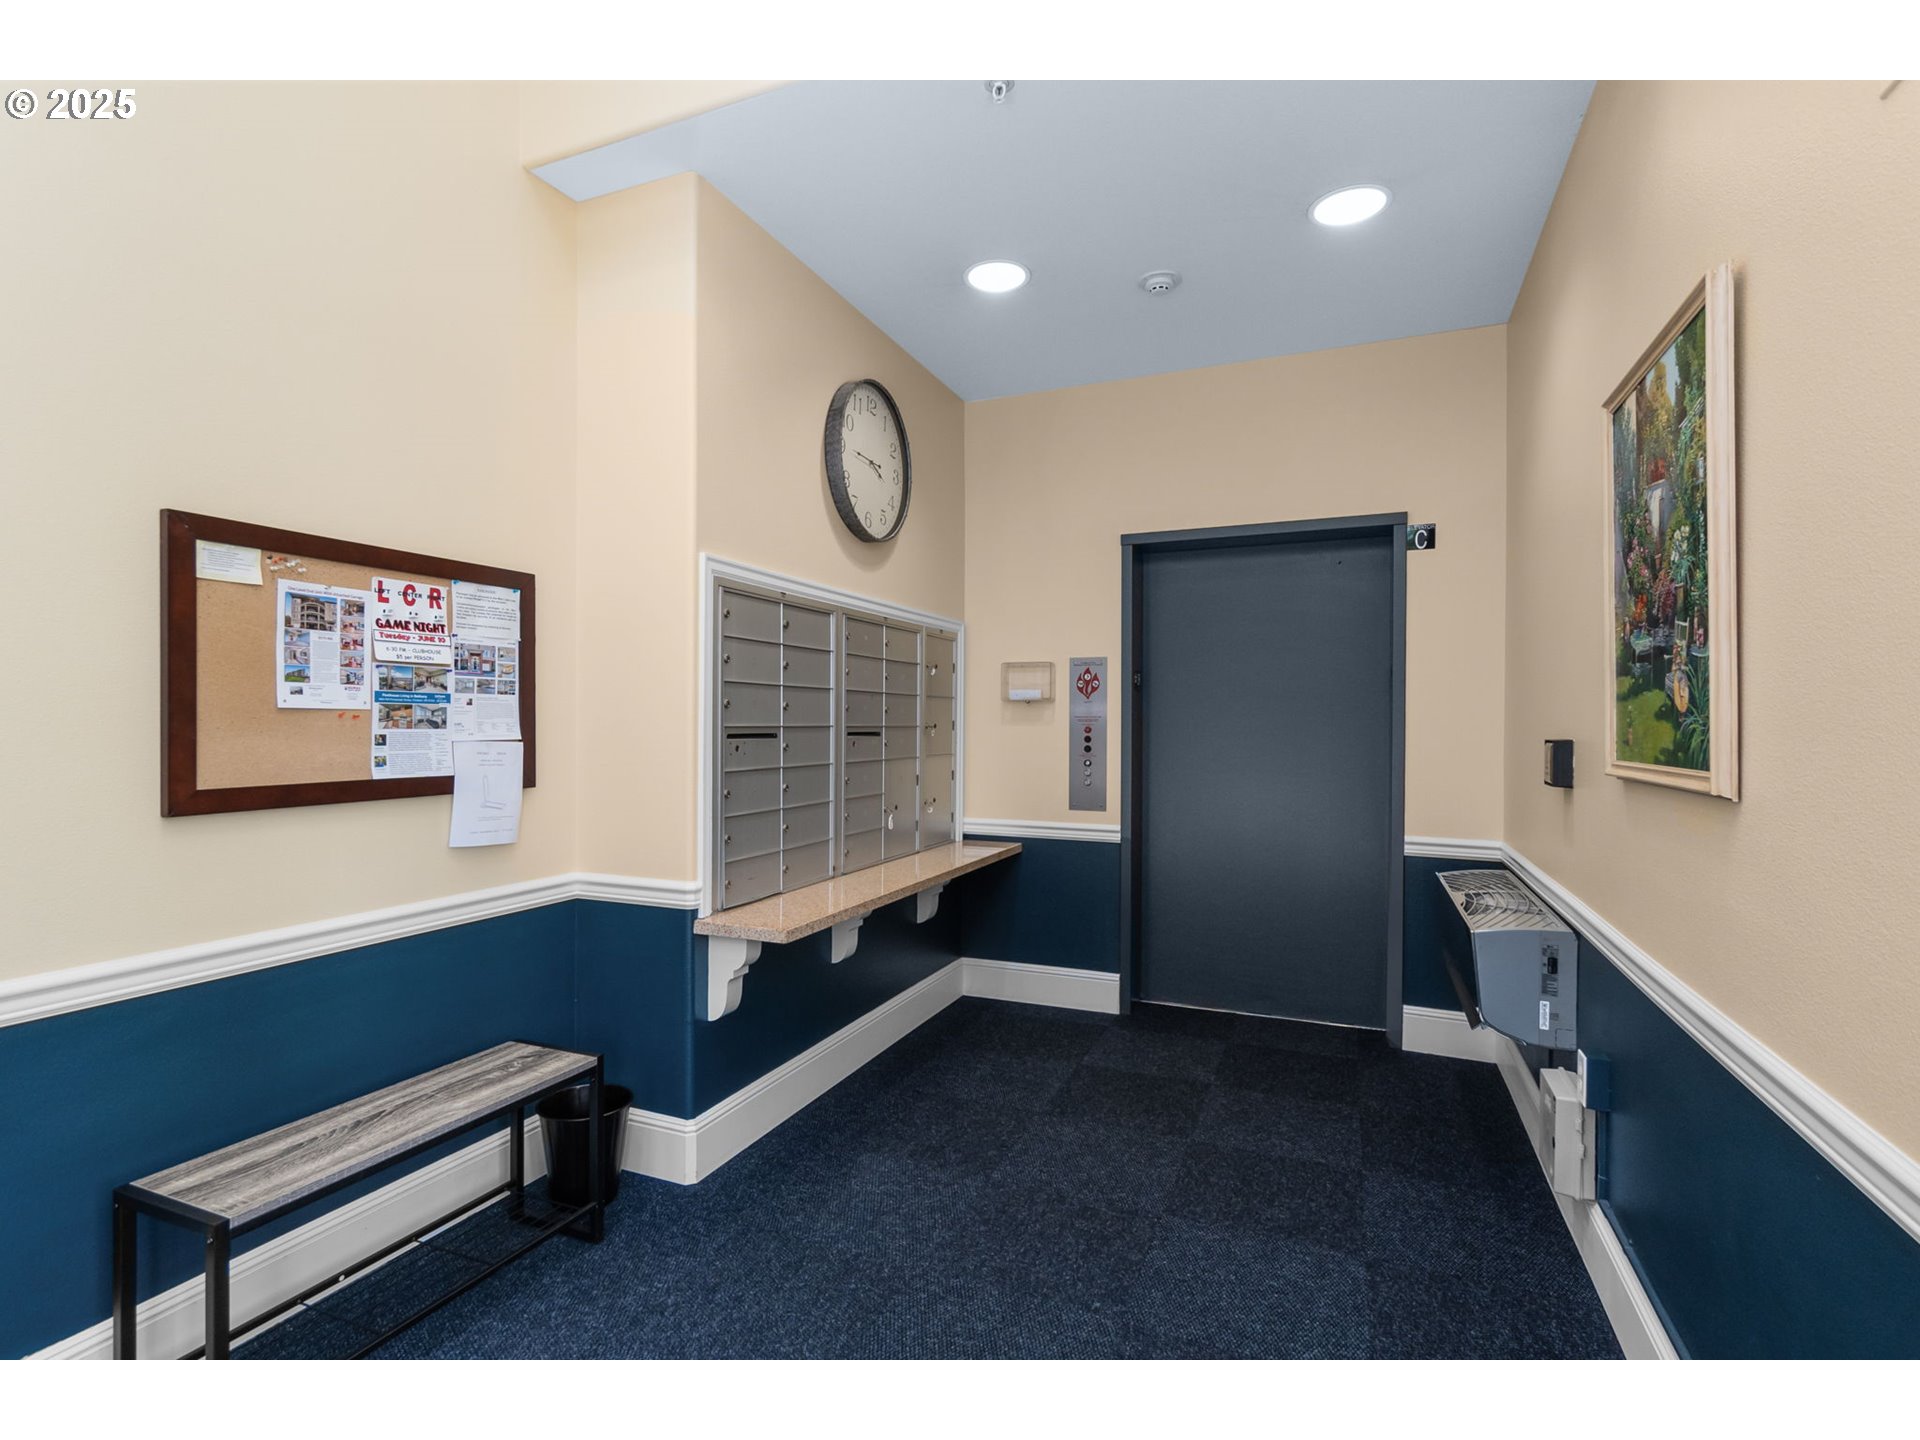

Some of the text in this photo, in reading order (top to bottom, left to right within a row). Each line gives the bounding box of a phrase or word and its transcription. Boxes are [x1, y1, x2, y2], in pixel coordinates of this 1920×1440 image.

[866, 395, 877, 416] 12
[889, 442, 897, 459] 2
[893, 469, 899, 486] 3
[887, 495, 895, 511] 4
[865, 511, 872, 529] 6
[879, 509, 887, 526] 5
[1415, 529, 1427, 549] C
[377, 580, 389, 603] L
[403, 584, 416, 606] C
[429, 587, 442, 609] R
[375, 618, 446, 634] GAME NIGHT
[379, 631, 410, 641] Tuesday
[418, 635, 436, 643] JUNE
